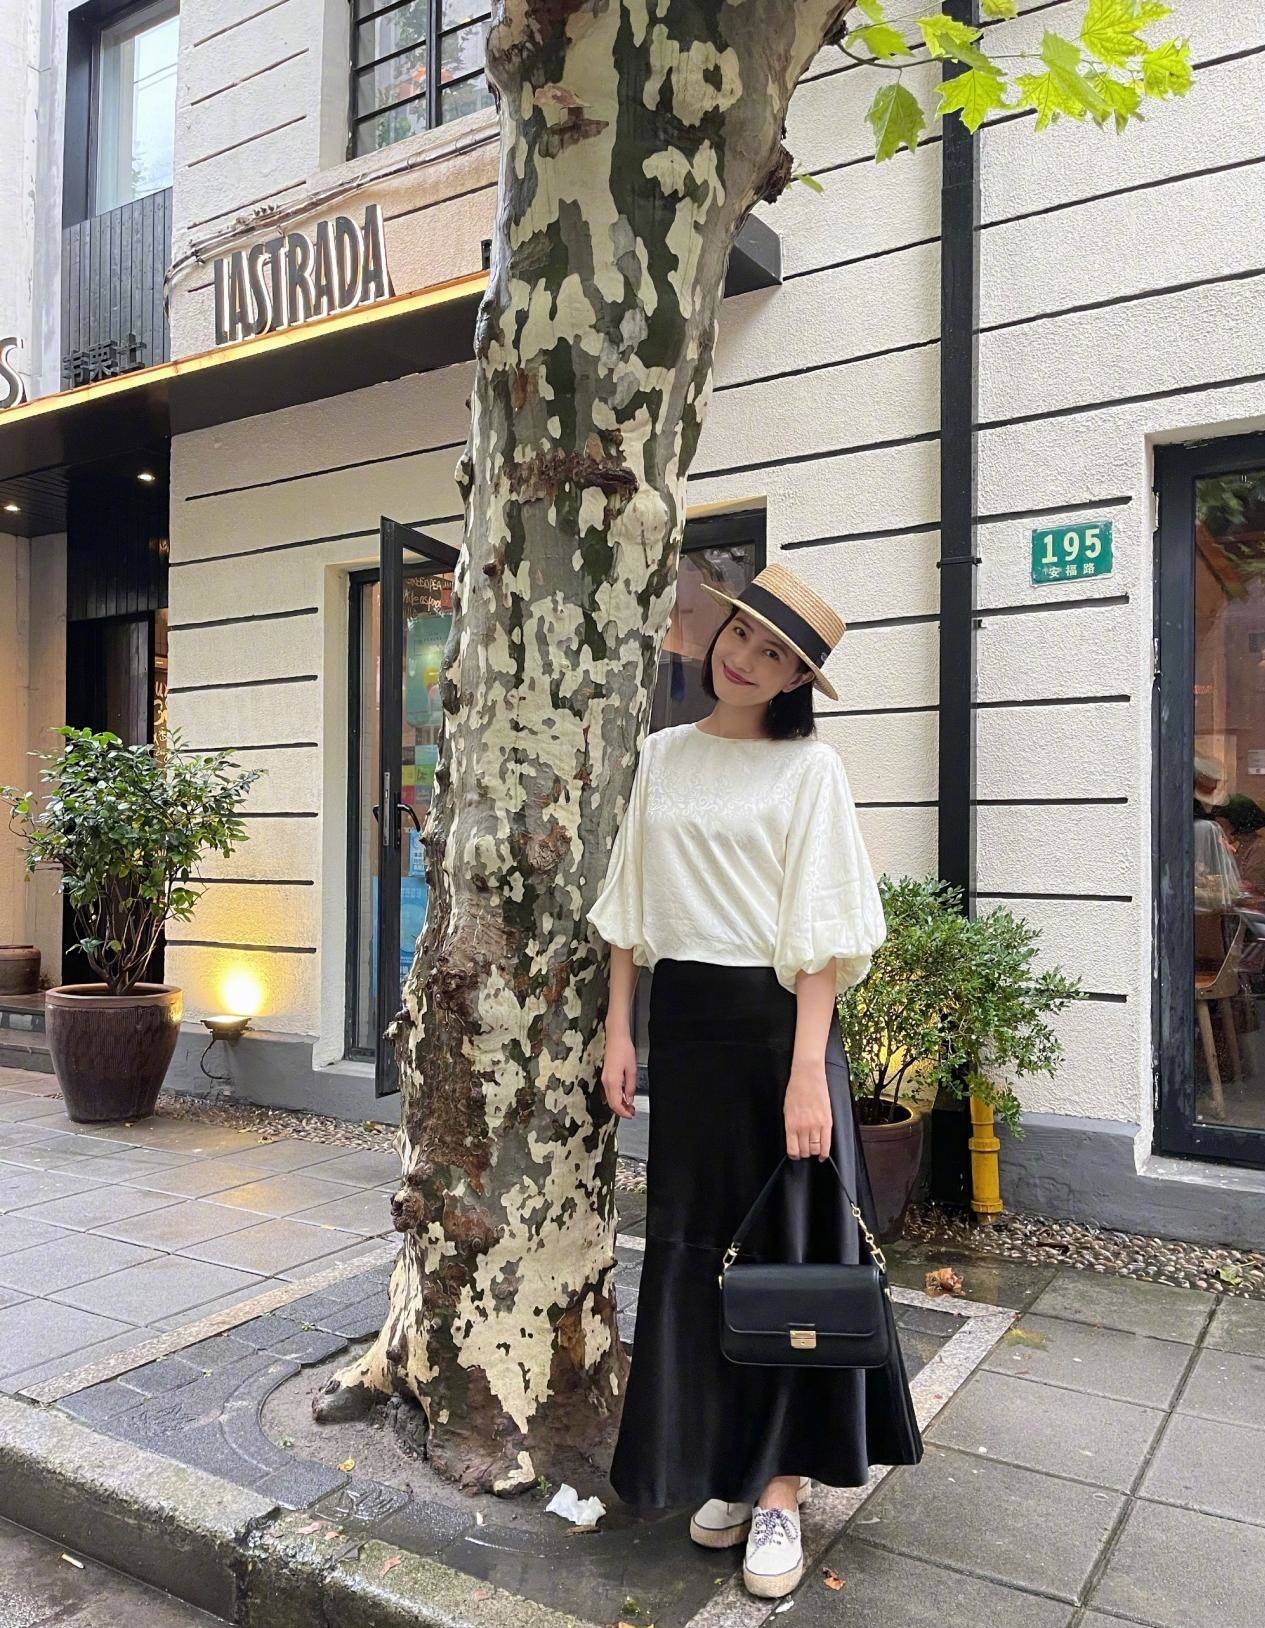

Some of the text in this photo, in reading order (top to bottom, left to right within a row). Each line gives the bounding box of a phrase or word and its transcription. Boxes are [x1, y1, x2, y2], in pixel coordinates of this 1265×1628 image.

[1041, 528, 1102, 564] 195
[1049, 563, 1095, 578] 安福路
